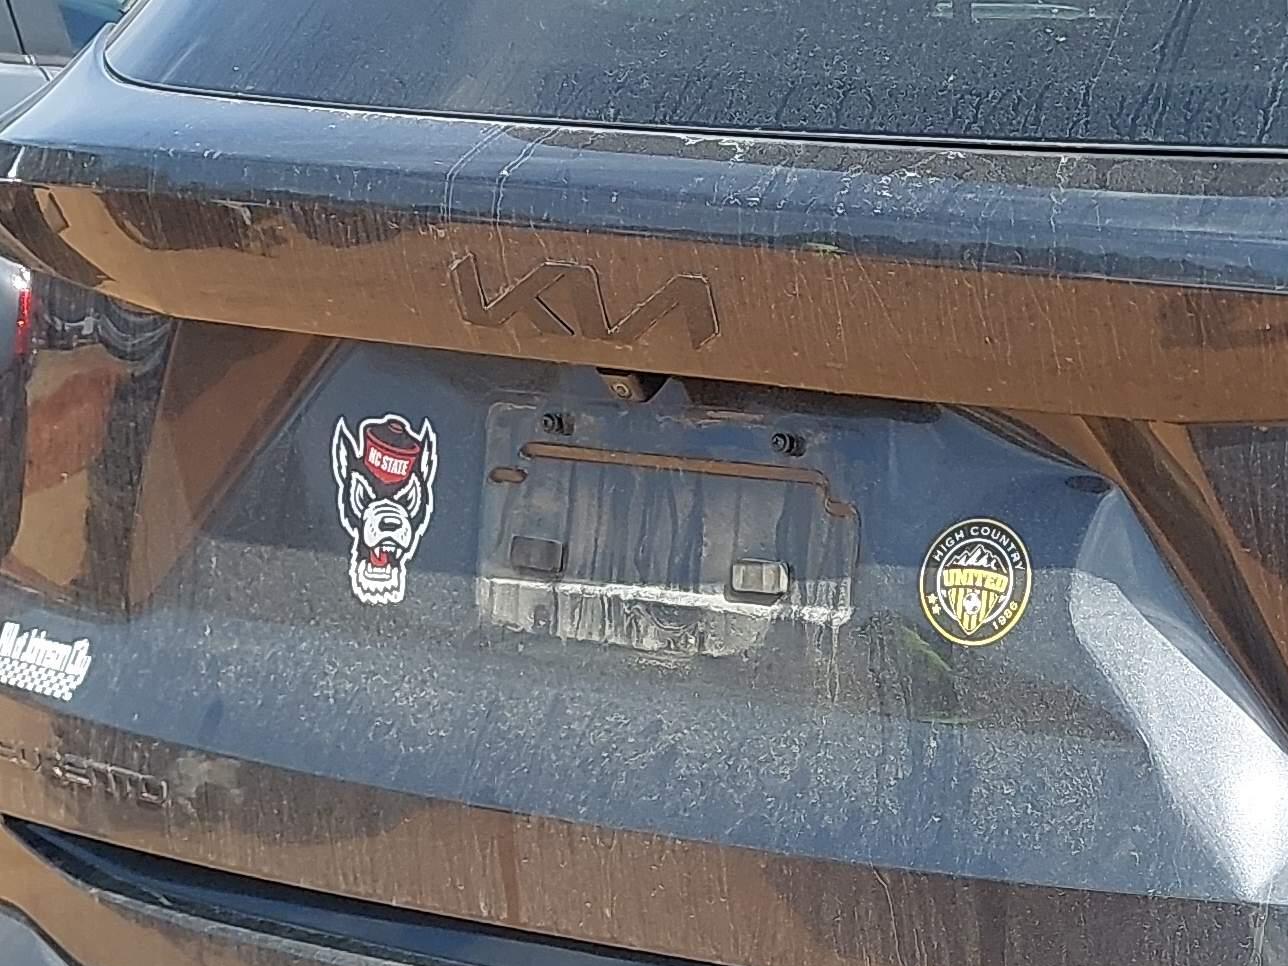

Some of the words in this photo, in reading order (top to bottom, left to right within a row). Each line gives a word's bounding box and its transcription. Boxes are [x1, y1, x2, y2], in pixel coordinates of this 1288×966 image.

[449, 252, 721, 350] KIA
[368, 446, 382, 467] NC
[381, 455, 410, 476] STATE
[932, 529, 965, 562] HIGH
[969, 526, 1025, 570] COUNTRY
[943, 568, 1009, 593] UNITED
[992, 600, 1018, 630] 1986
